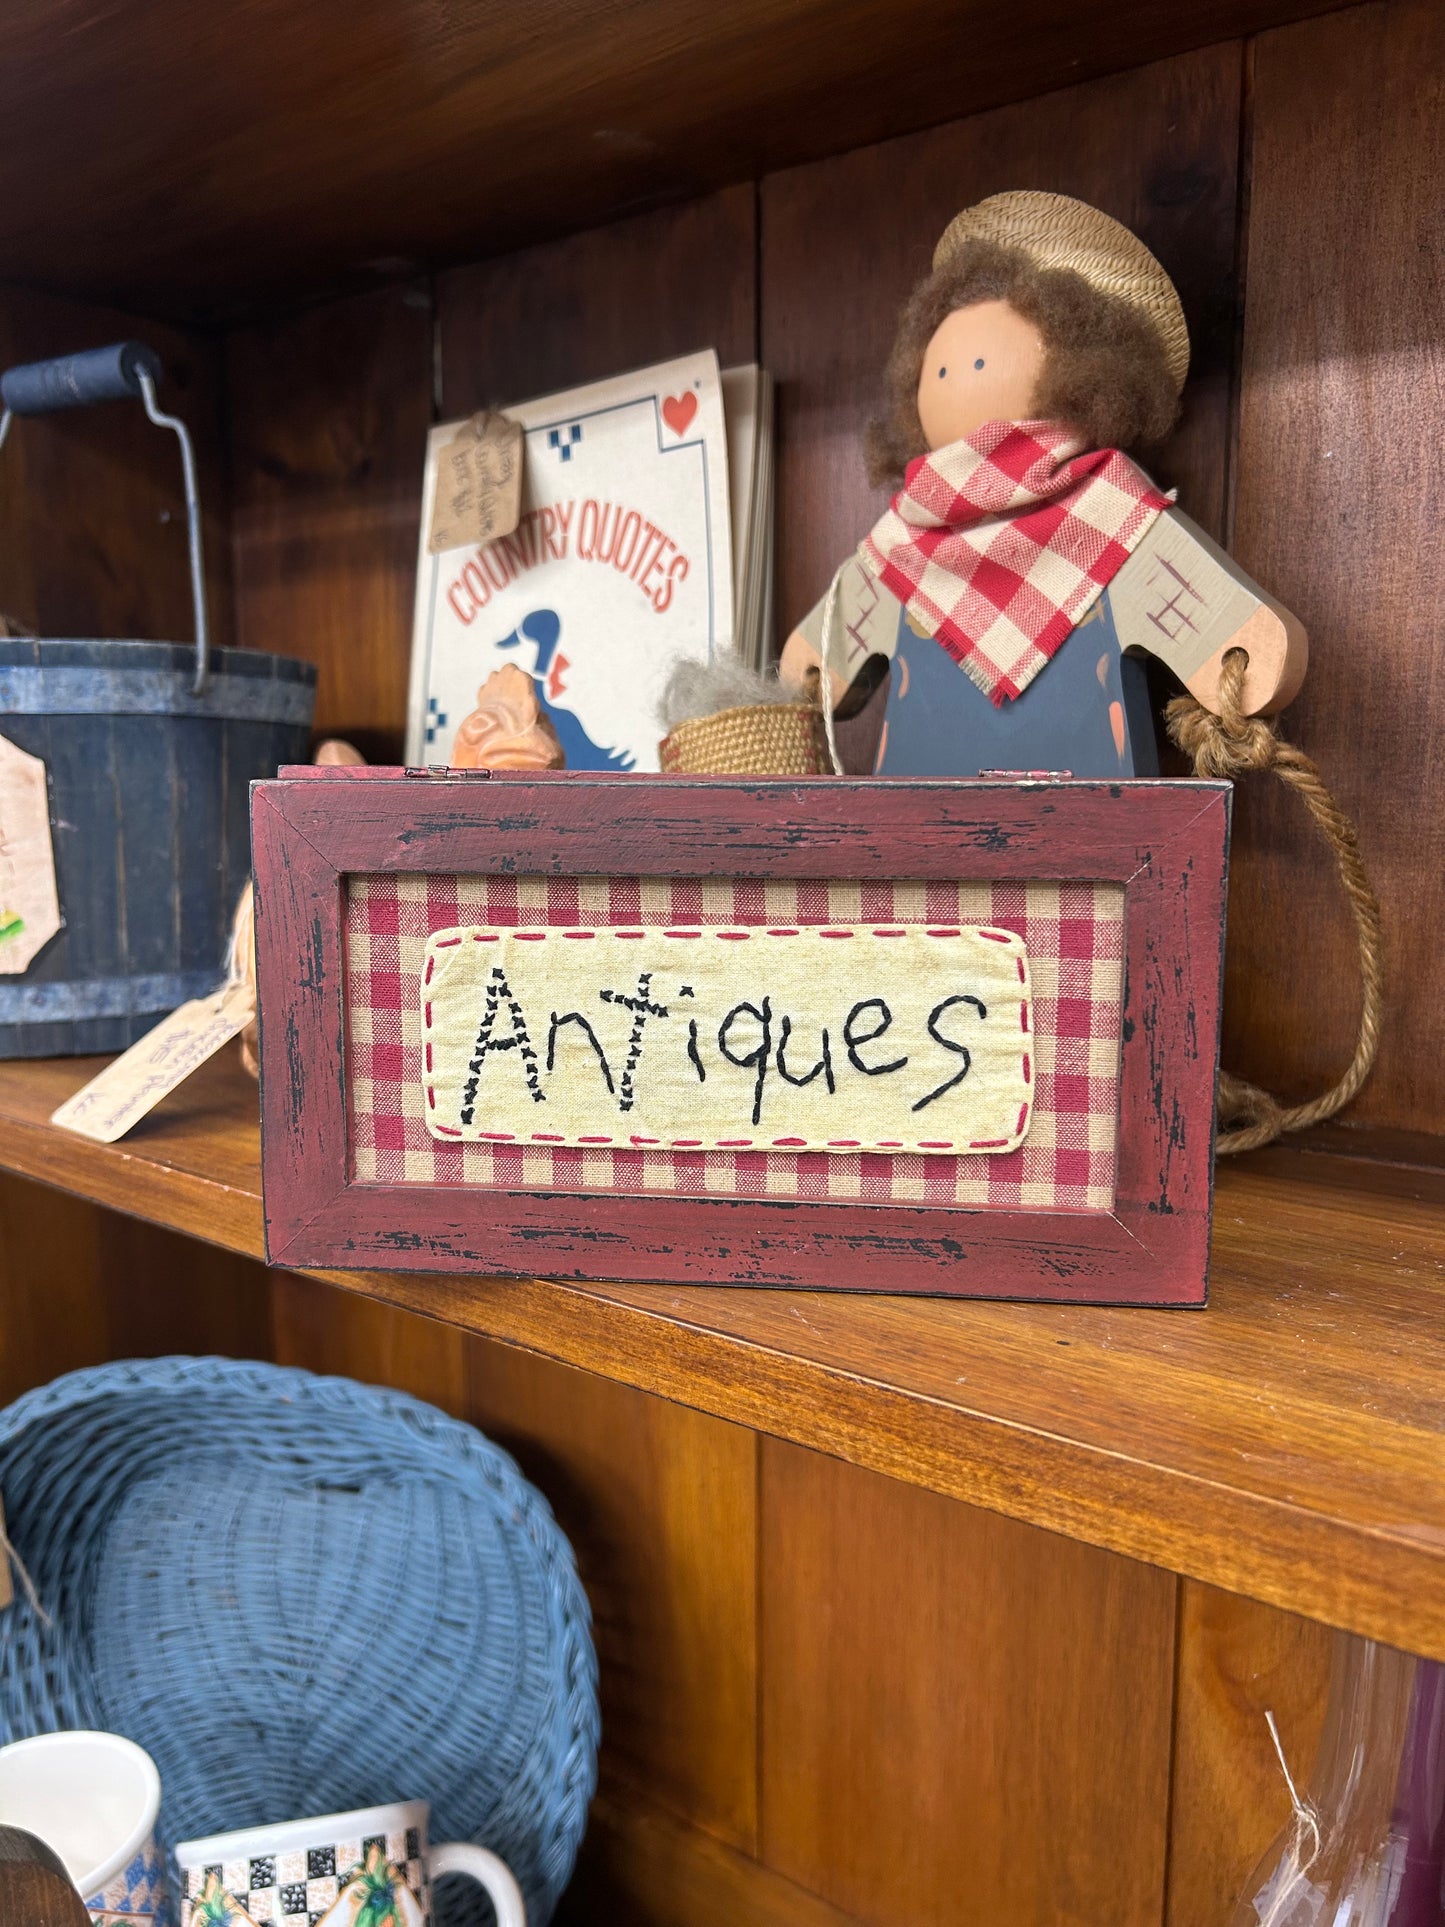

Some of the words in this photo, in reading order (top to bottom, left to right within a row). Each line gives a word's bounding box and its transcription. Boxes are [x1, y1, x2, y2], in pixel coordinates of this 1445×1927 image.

[447, 500, 574, 627] COUNTRY
[576, 499, 690, 614] QUOTES
[460, 967, 987, 1125] Antiques
